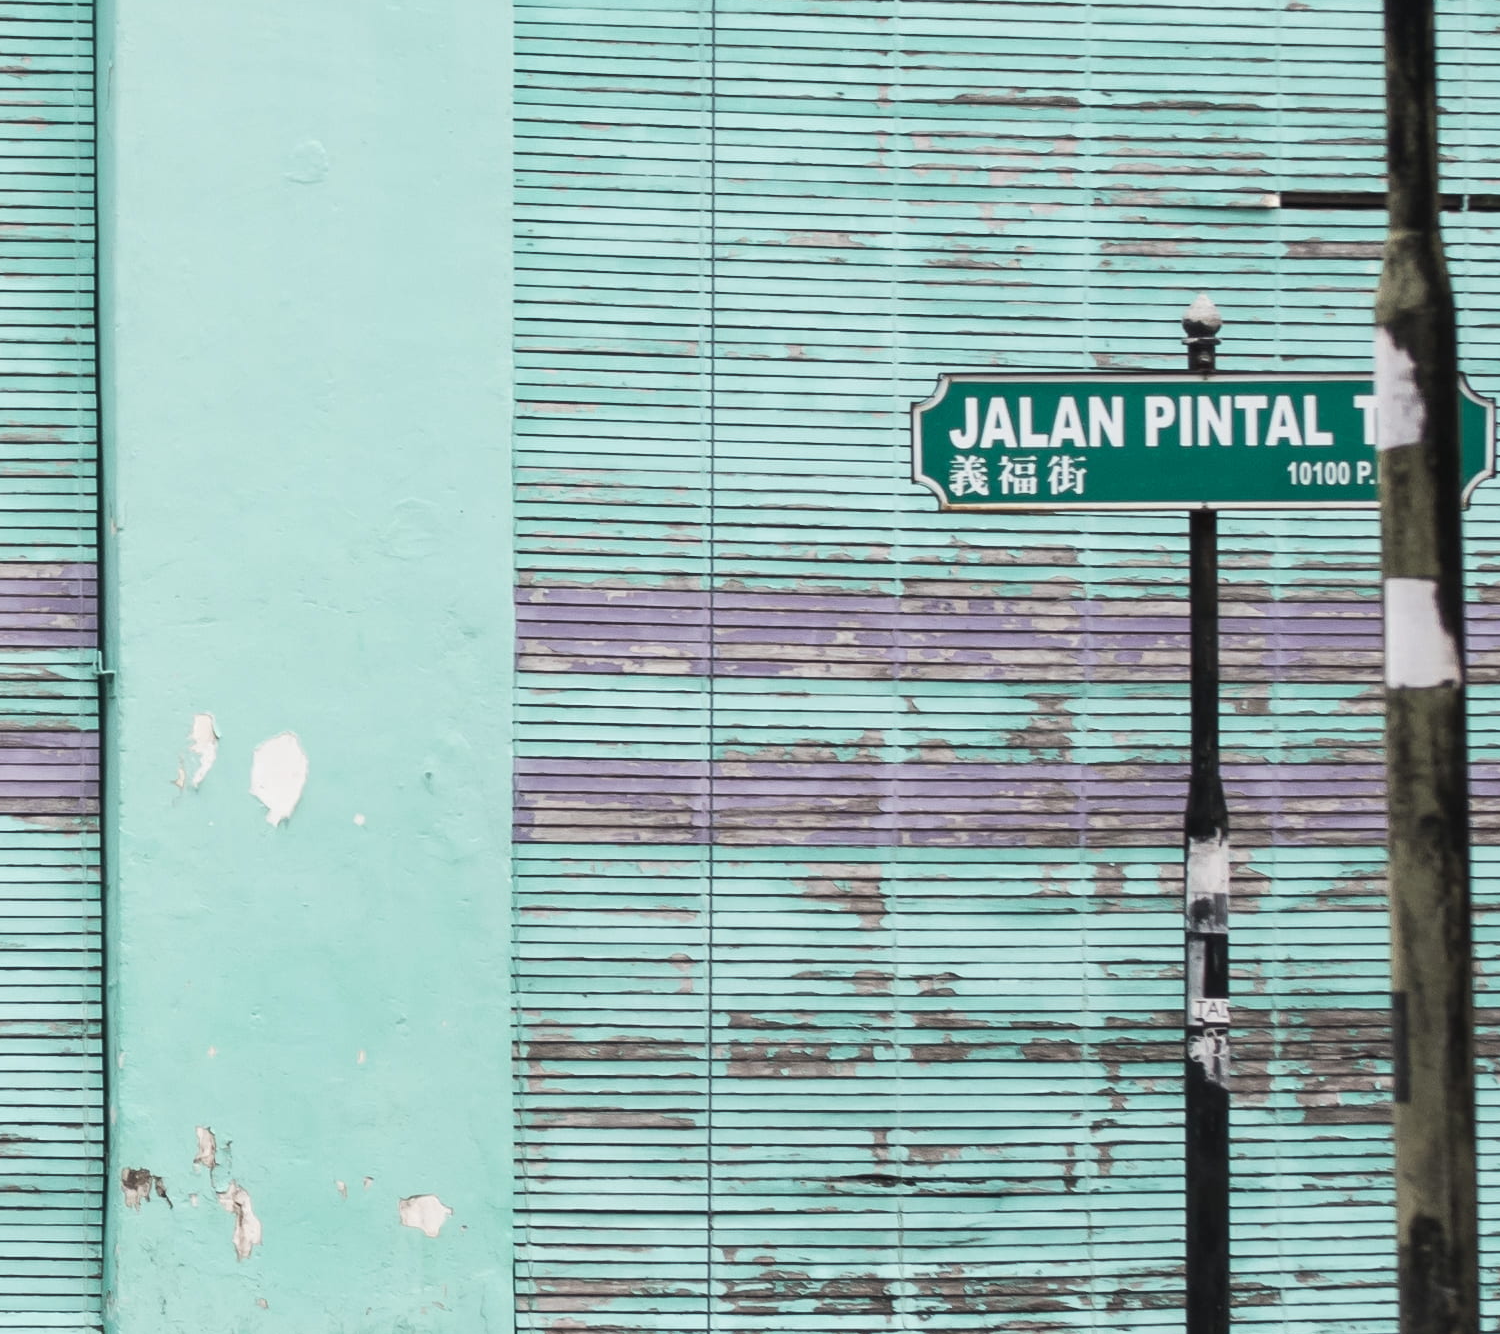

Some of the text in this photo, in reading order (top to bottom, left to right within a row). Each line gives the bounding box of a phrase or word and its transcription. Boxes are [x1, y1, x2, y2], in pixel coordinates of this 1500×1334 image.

[949, 395, 1125, 449] JALAN
[1145, 394, 1333, 448] PINTAL
[948, 455, 1088, 496] 義福街
[1287, 461, 1351, 485] 10100
